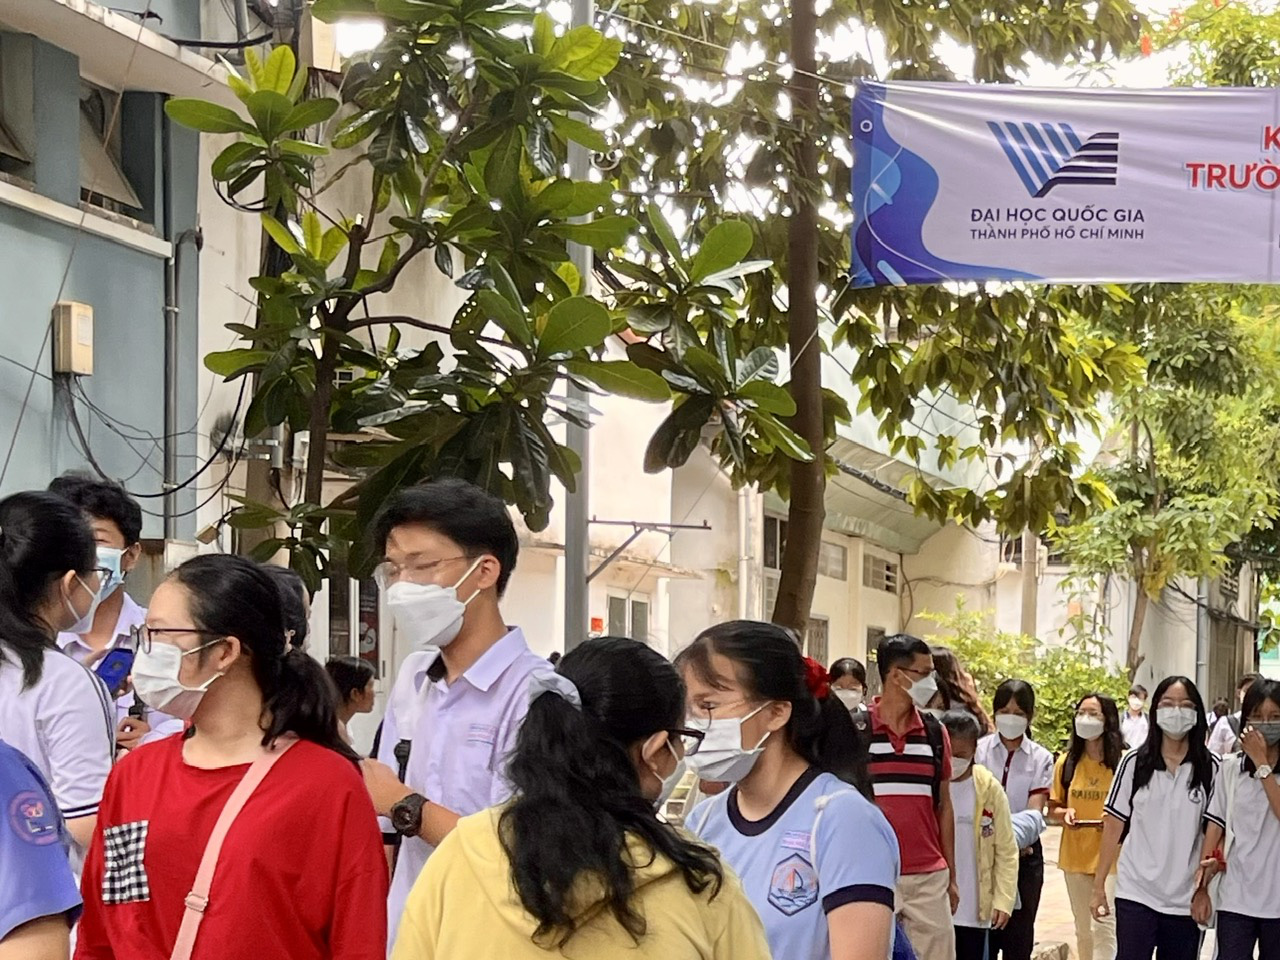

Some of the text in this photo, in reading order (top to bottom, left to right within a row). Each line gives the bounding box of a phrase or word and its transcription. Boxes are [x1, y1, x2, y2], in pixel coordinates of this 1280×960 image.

[1006, 208, 1047, 226] HỌC
[1052, 204, 1108, 222] QUỐC
[1113, 208, 1145, 222] GIA
[970, 223, 1017, 240] THÀNH
[1079, 225, 1105, 240] CHÍ
[1107, 228, 1144, 240] MINH
